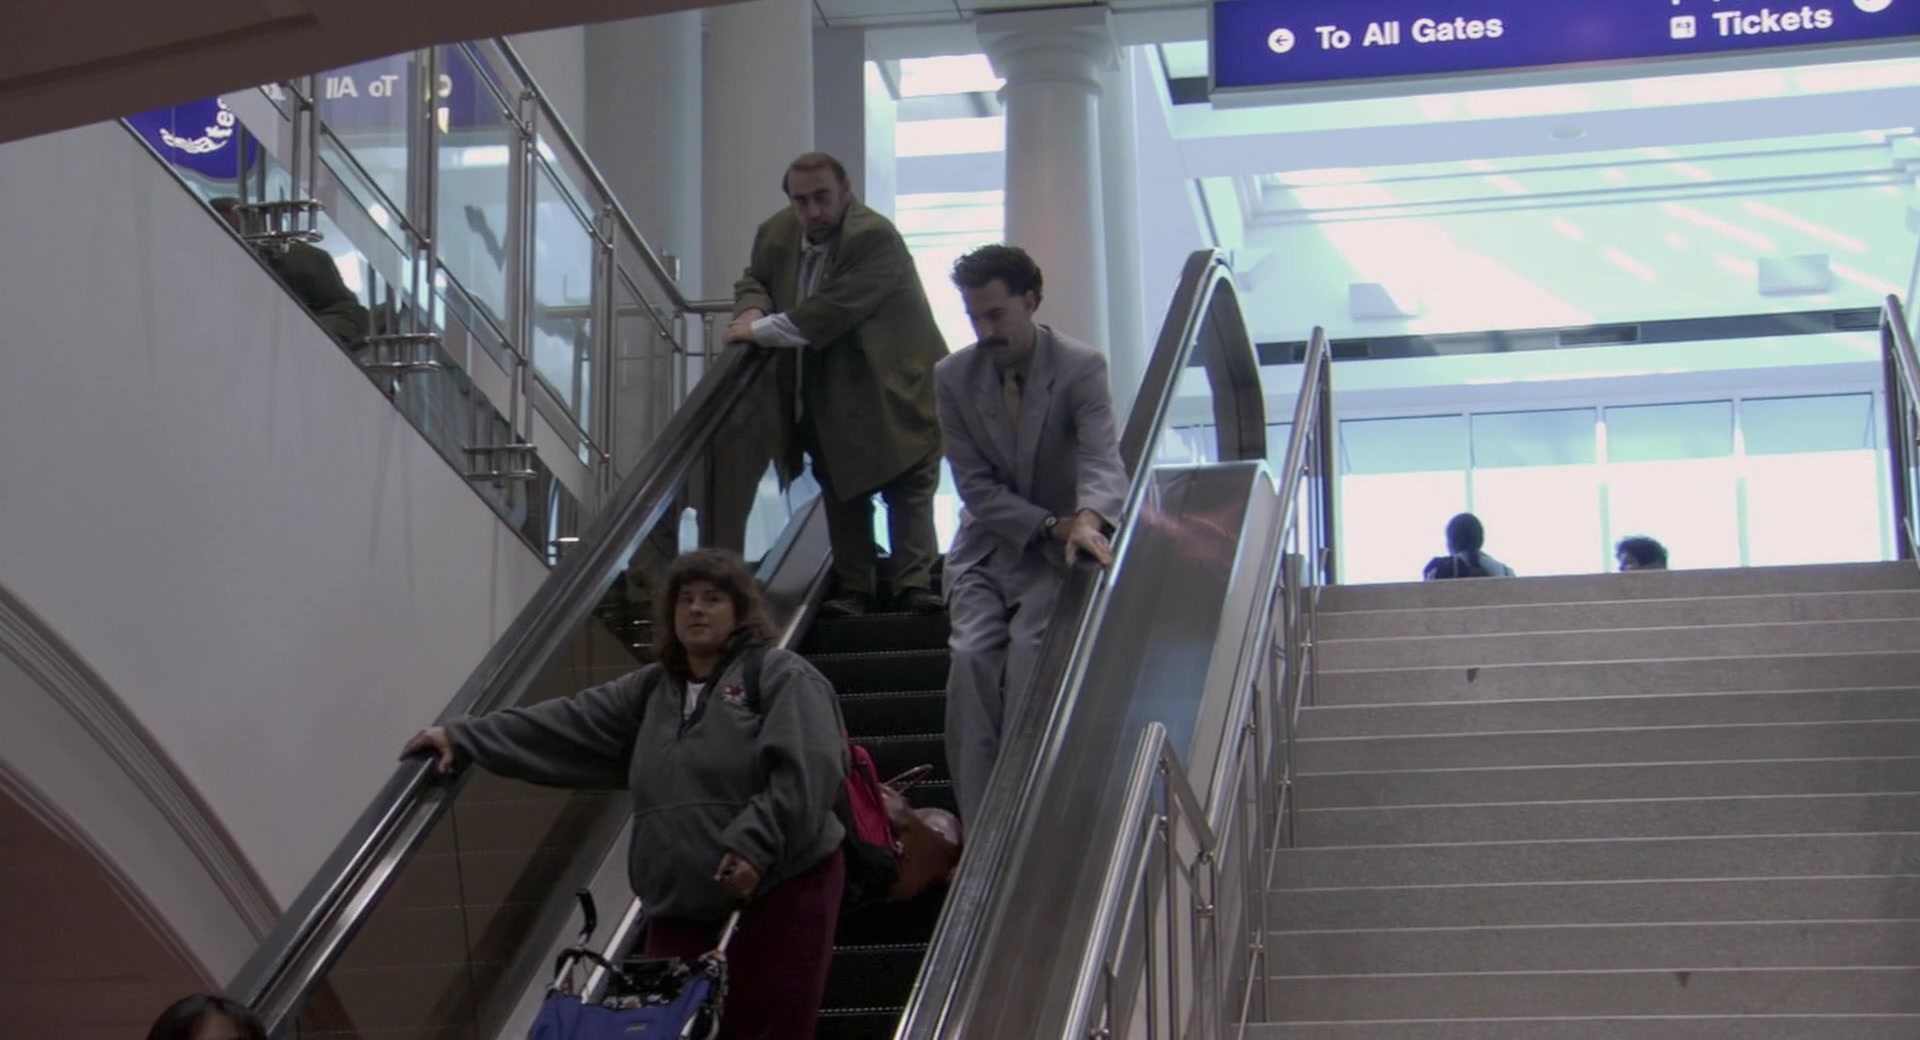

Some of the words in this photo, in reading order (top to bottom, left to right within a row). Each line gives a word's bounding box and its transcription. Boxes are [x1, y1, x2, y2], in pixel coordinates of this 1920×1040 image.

[1314, 25, 1351, 49] To
[1362, 21, 1400, 46] All
[1411, 17, 1504, 43] Gates
[1712, 6, 1834, 36] Tickets
